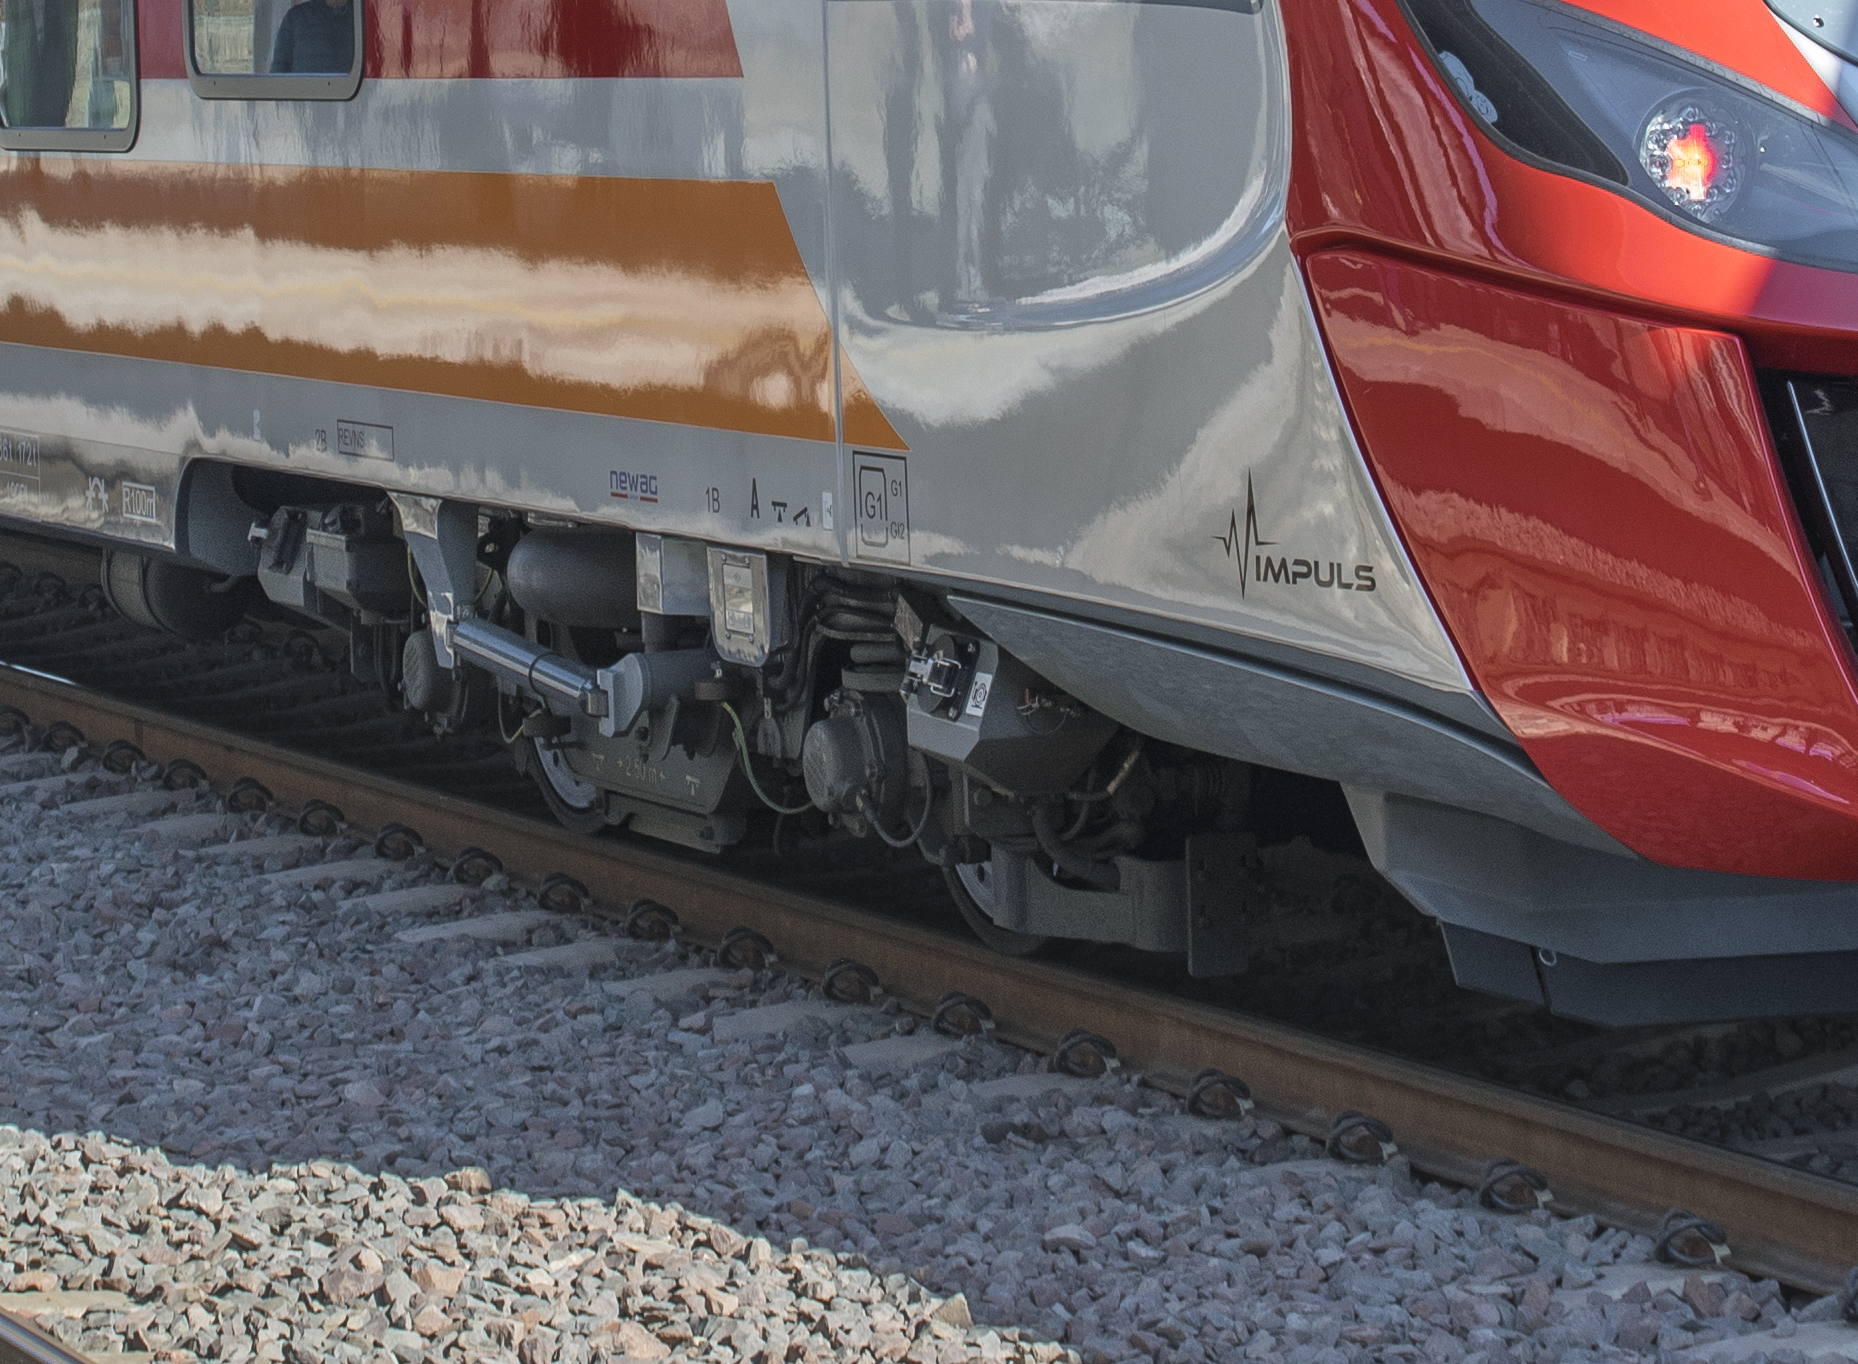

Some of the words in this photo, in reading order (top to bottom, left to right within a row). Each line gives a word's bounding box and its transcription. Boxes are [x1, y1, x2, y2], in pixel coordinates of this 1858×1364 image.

[315, 428, 328, 453] 2B
[124, 488, 155, 519] R100m
[705, 486, 721, 514] 1B
[750, 477, 760, 519] A
[890, 479, 903, 498] G1
[864, 490, 884, 521] G1
[1255, 555, 1376, 592] IMPULS
